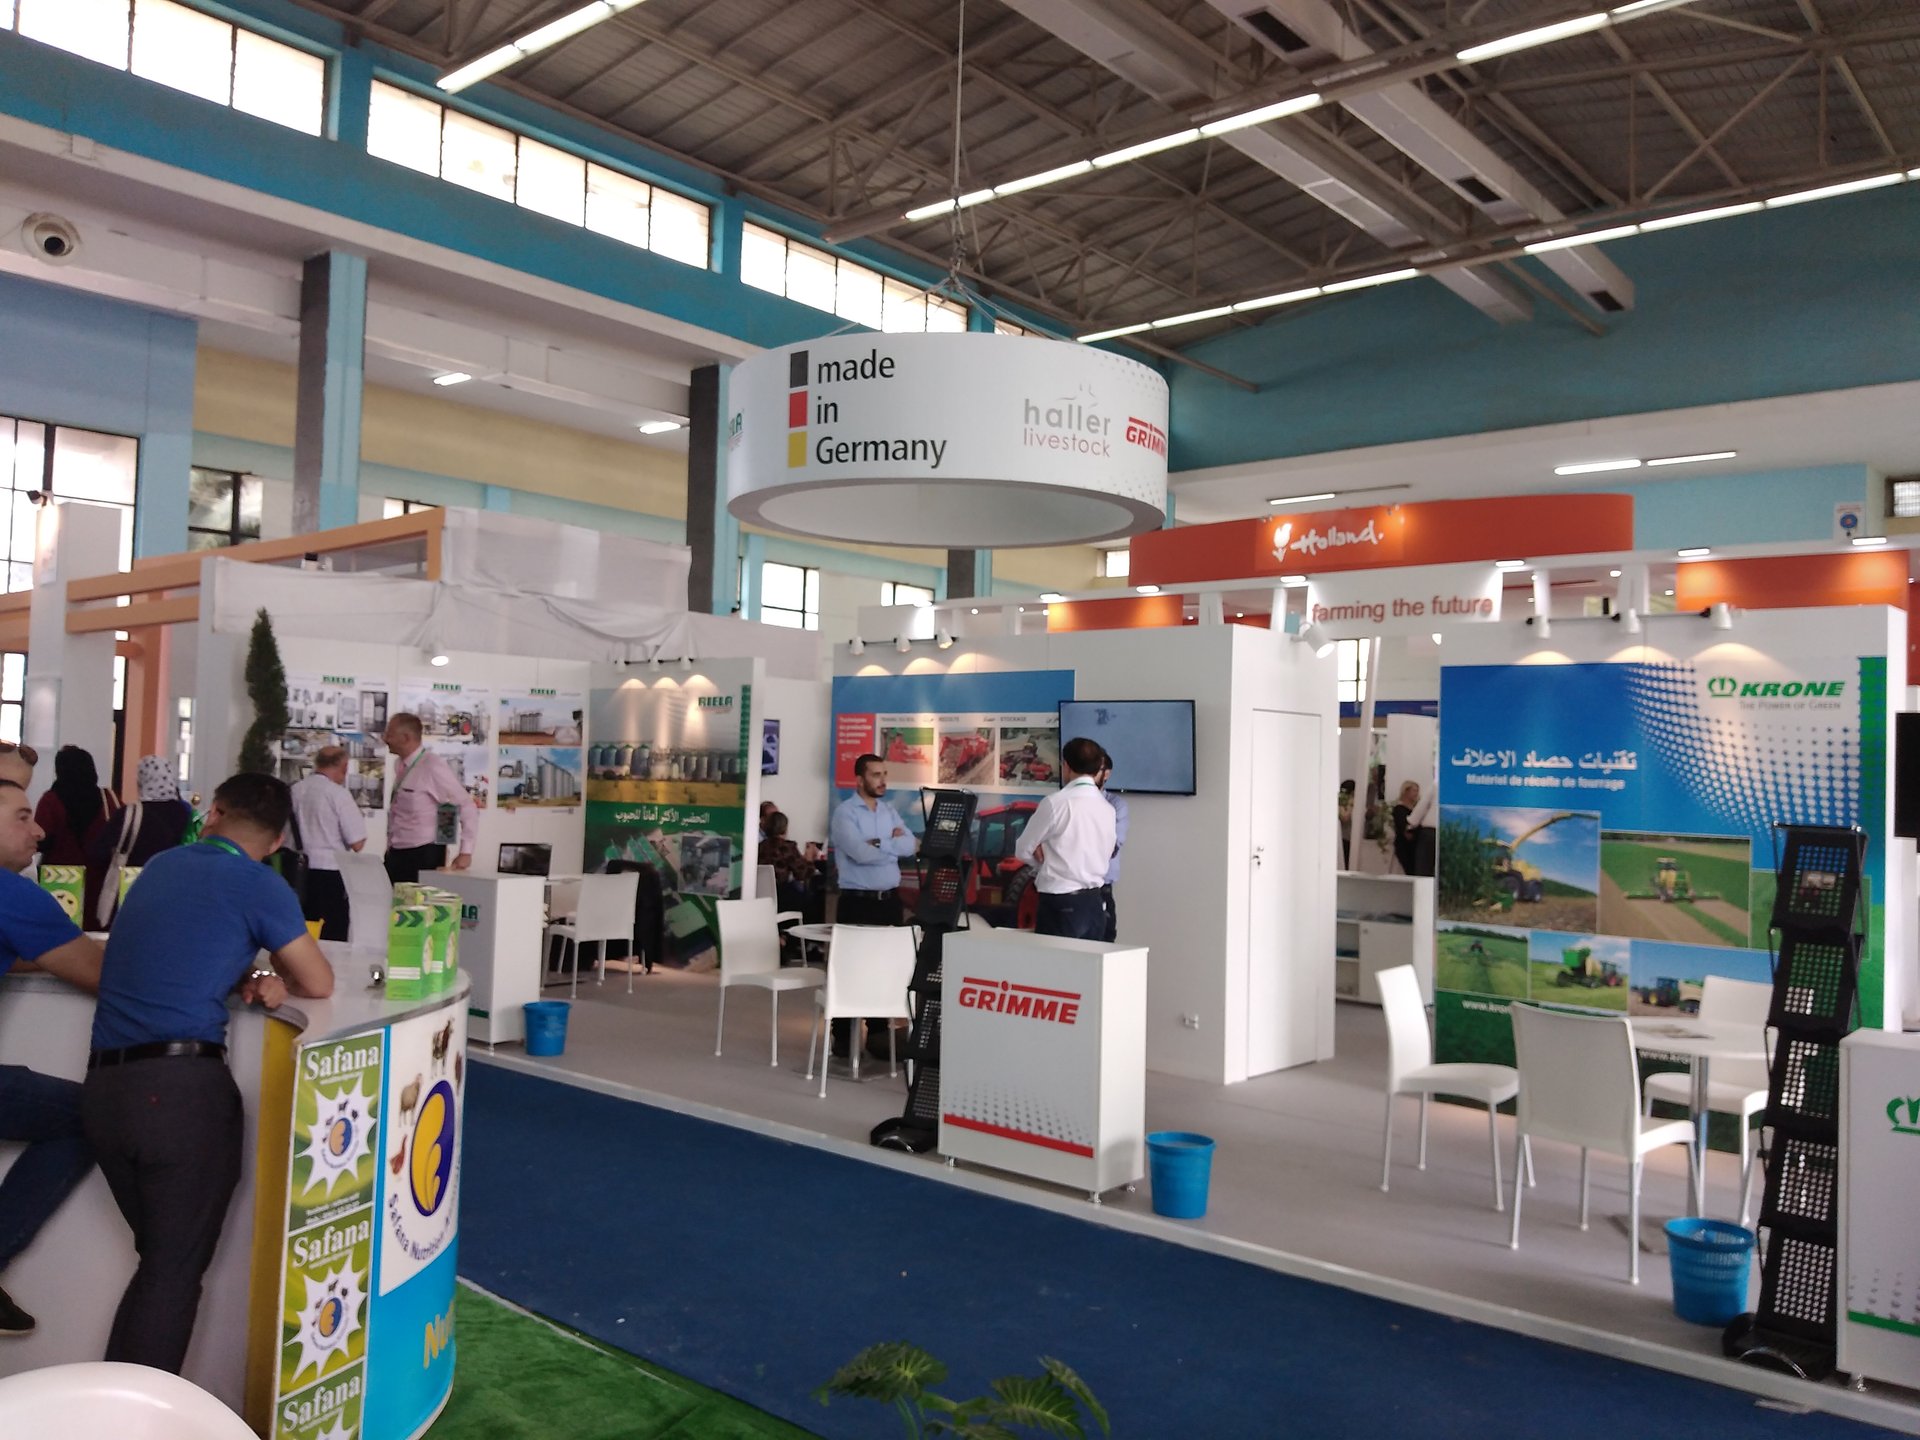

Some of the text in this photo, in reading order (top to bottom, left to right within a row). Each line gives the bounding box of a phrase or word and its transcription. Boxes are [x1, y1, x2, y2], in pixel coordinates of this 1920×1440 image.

[817, 348, 896, 385] made
[816, 395, 839, 425] in
[1023, 398, 1111, 436] haller
[815, 435, 947, 469] Germany
[1023, 427, 1111, 458] livestock
[1312, 596, 1493, 624] farming the future
[698, 696, 733, 707] RIELA
[1740, 681, 1845, 697] KRONE
[1522, 750, 1574, 769] حصاد
[1578, 749, 1638, 775] تقنيات
[1509, 774, 1522, 787] de
[1562, 777, 1576, 788] de
[959, 980, 1079, 1025] GRIMME
[304, 1045, 379, 1081] Safana
[293, 1220, 369, 1268] Safana
[283, 1376, 361, 1434] Safana
